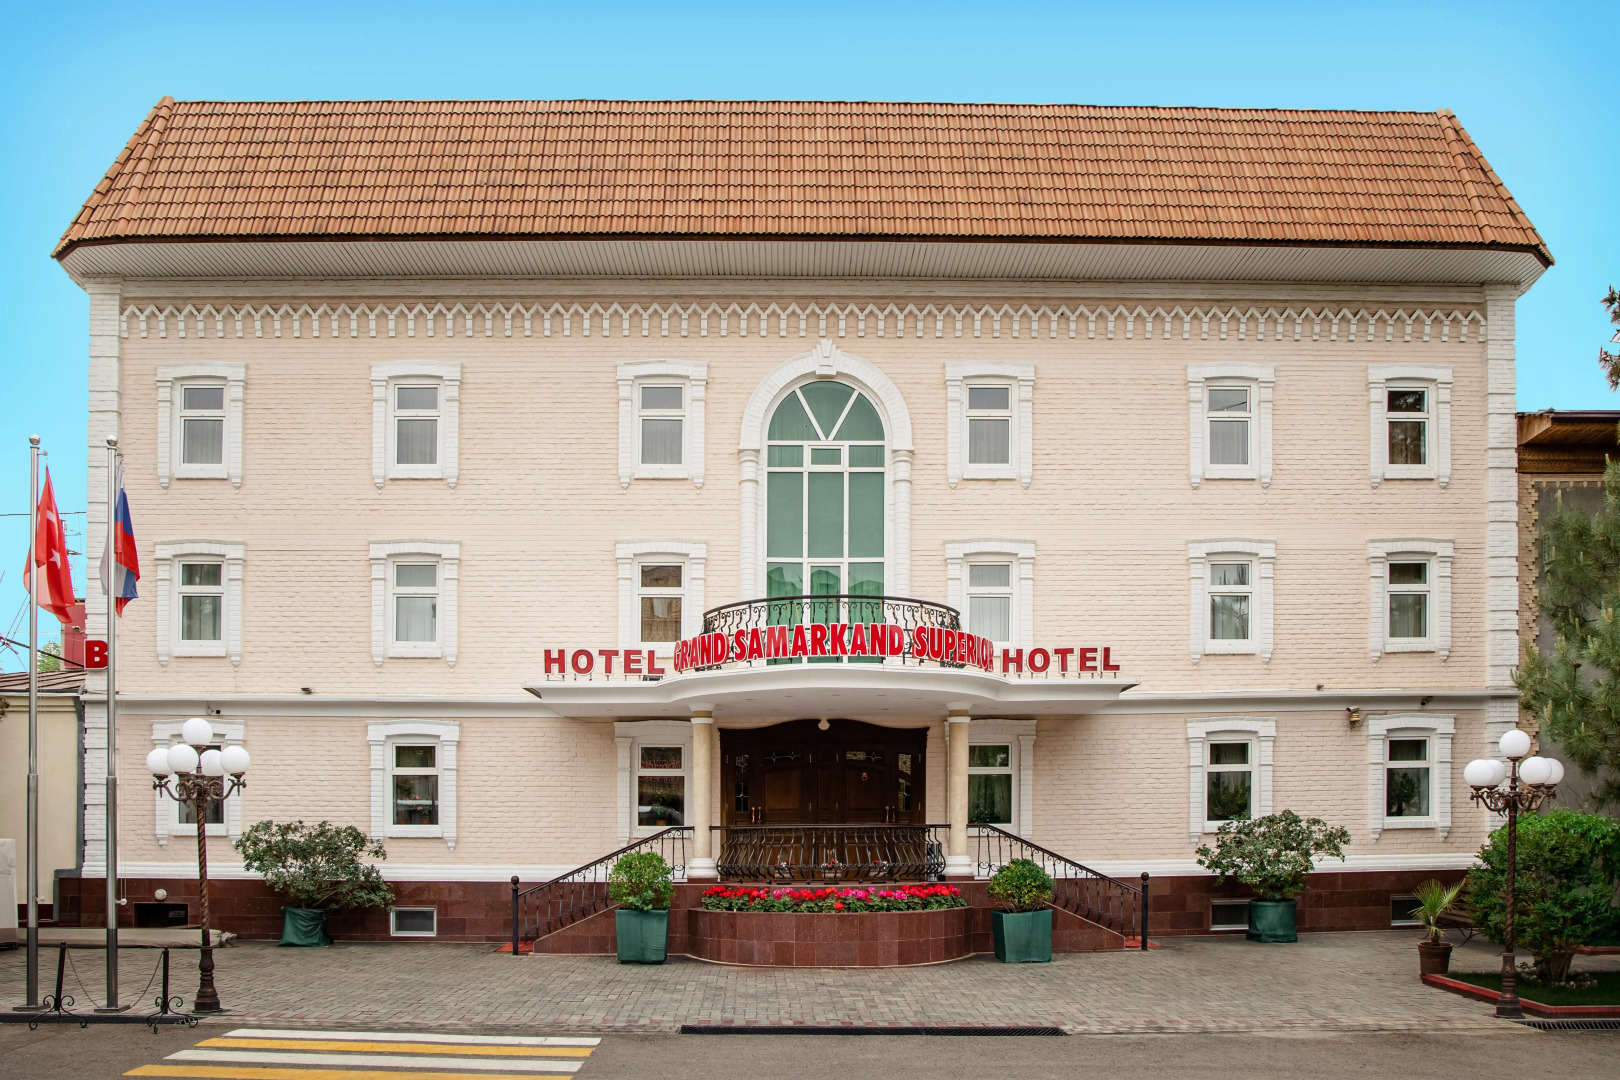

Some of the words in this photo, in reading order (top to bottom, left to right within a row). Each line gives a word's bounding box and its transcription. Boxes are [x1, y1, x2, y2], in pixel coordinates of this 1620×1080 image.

[84, 640, 109, 669] B
[543, 648, 666, 675] HOTEL
[674, 632, 730, 672] GRAND
[734, 623, 905, 662] SAMARKAND
[912, 625, 995, 671] SUPERIOR
[1001, 646, 1121, 674] HOTEL
